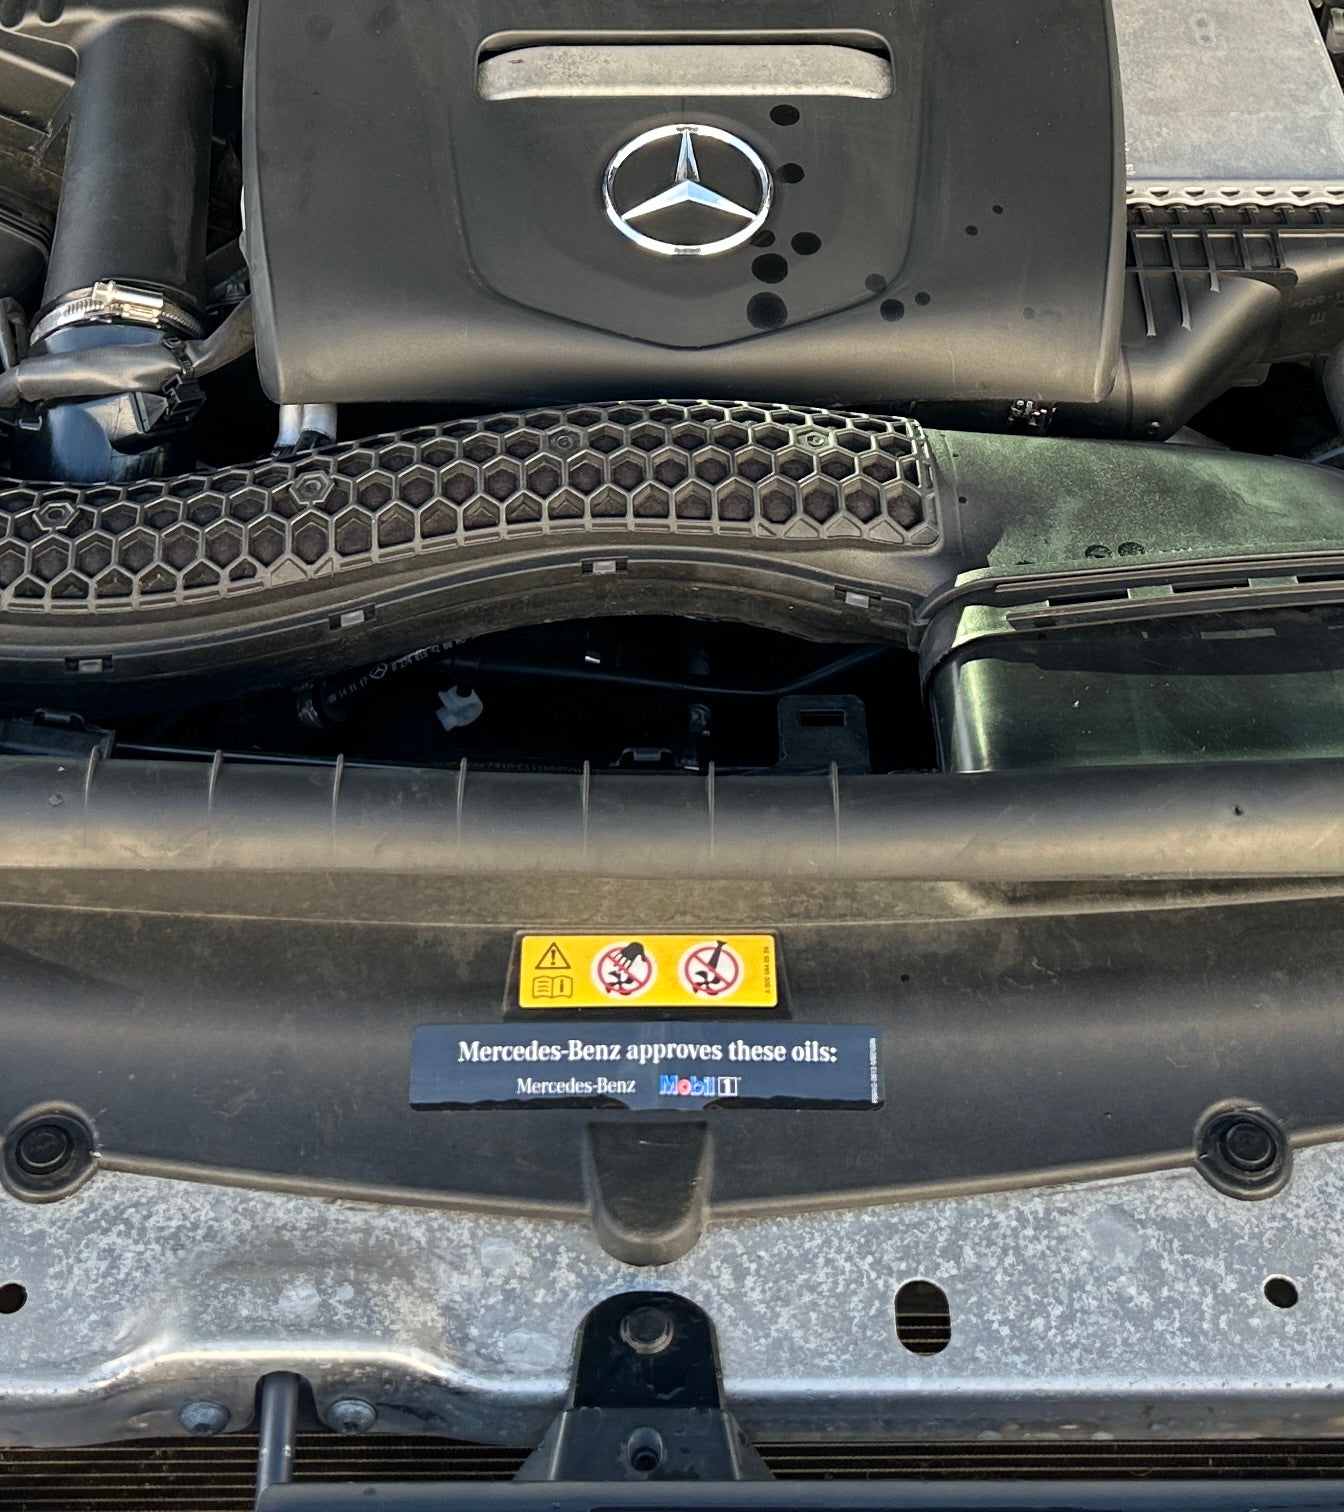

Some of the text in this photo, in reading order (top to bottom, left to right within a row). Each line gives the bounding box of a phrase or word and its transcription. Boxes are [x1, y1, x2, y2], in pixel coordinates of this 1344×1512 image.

[457, 1039, 838, 1065] Mercedes-Benz approves these oils:
[516, 1074, 737, 1097] Mercedes-Benz Mobil 1
